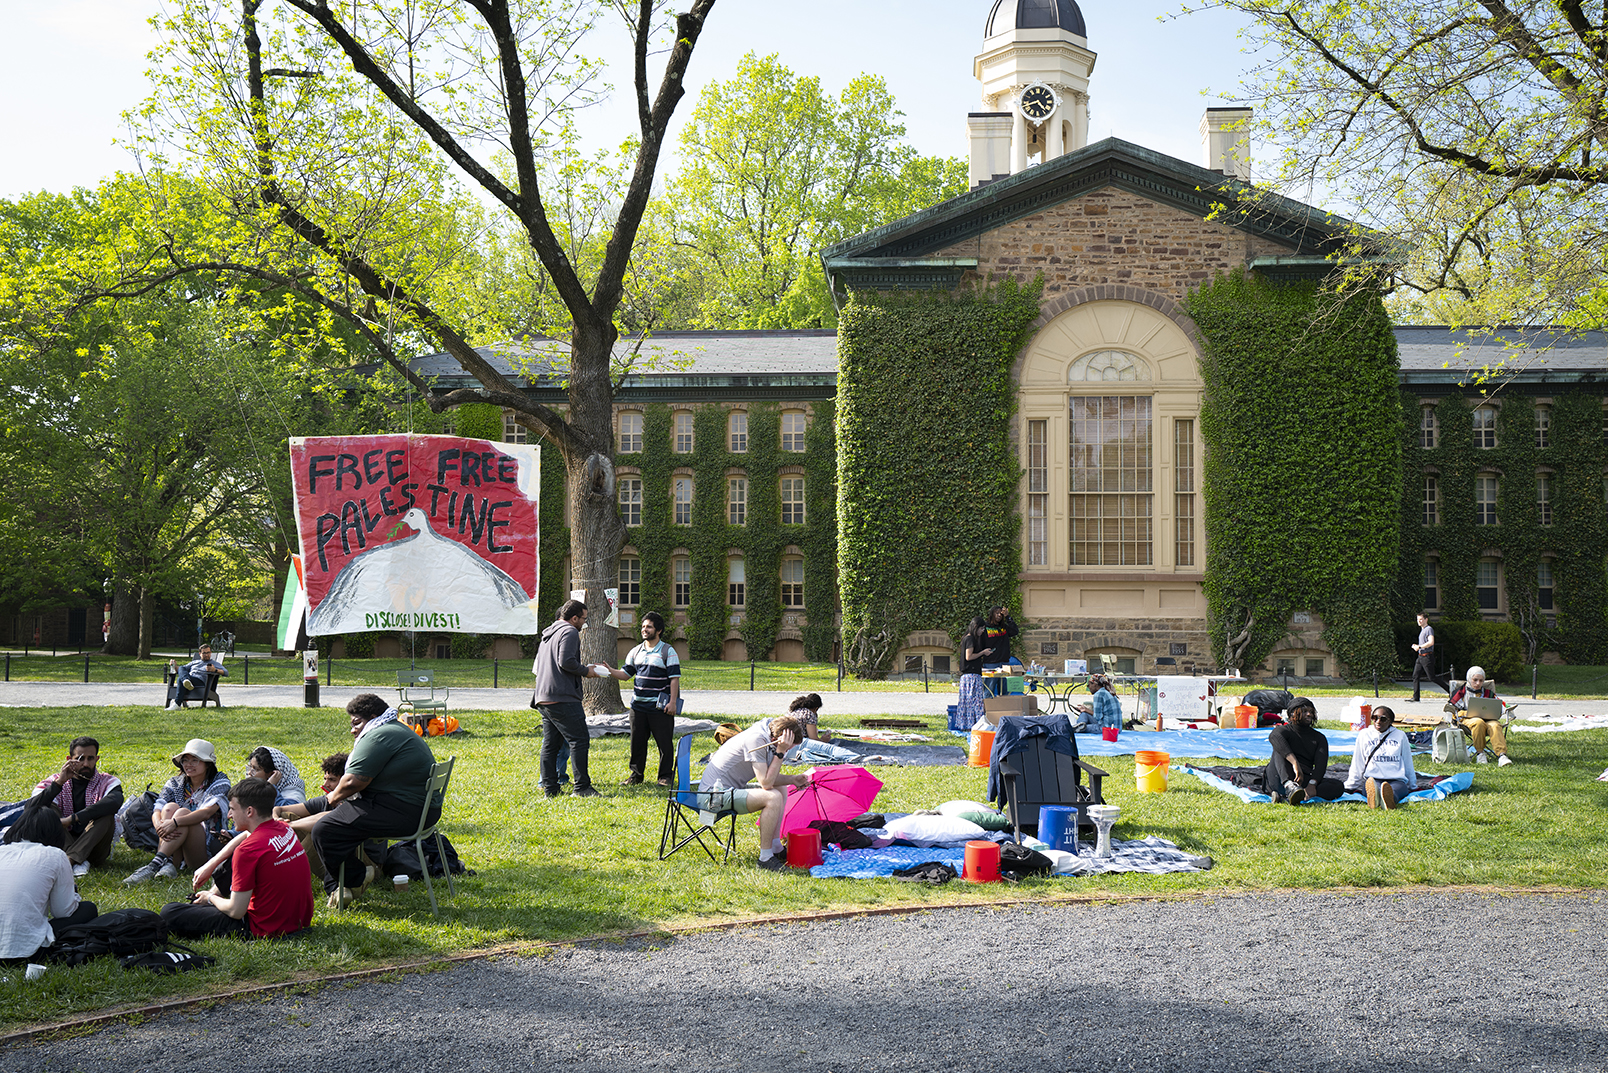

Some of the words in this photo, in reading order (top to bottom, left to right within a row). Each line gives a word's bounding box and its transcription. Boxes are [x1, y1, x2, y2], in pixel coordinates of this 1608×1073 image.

[309, 449, 409, 494] FREE
[437, 448, 518, 487] FREE
[316, 483, 513, 572] PALESTINE
[365, 611, 411, 628] DISCLOSE!
[414, 612, 460, 629] DIVEST!
